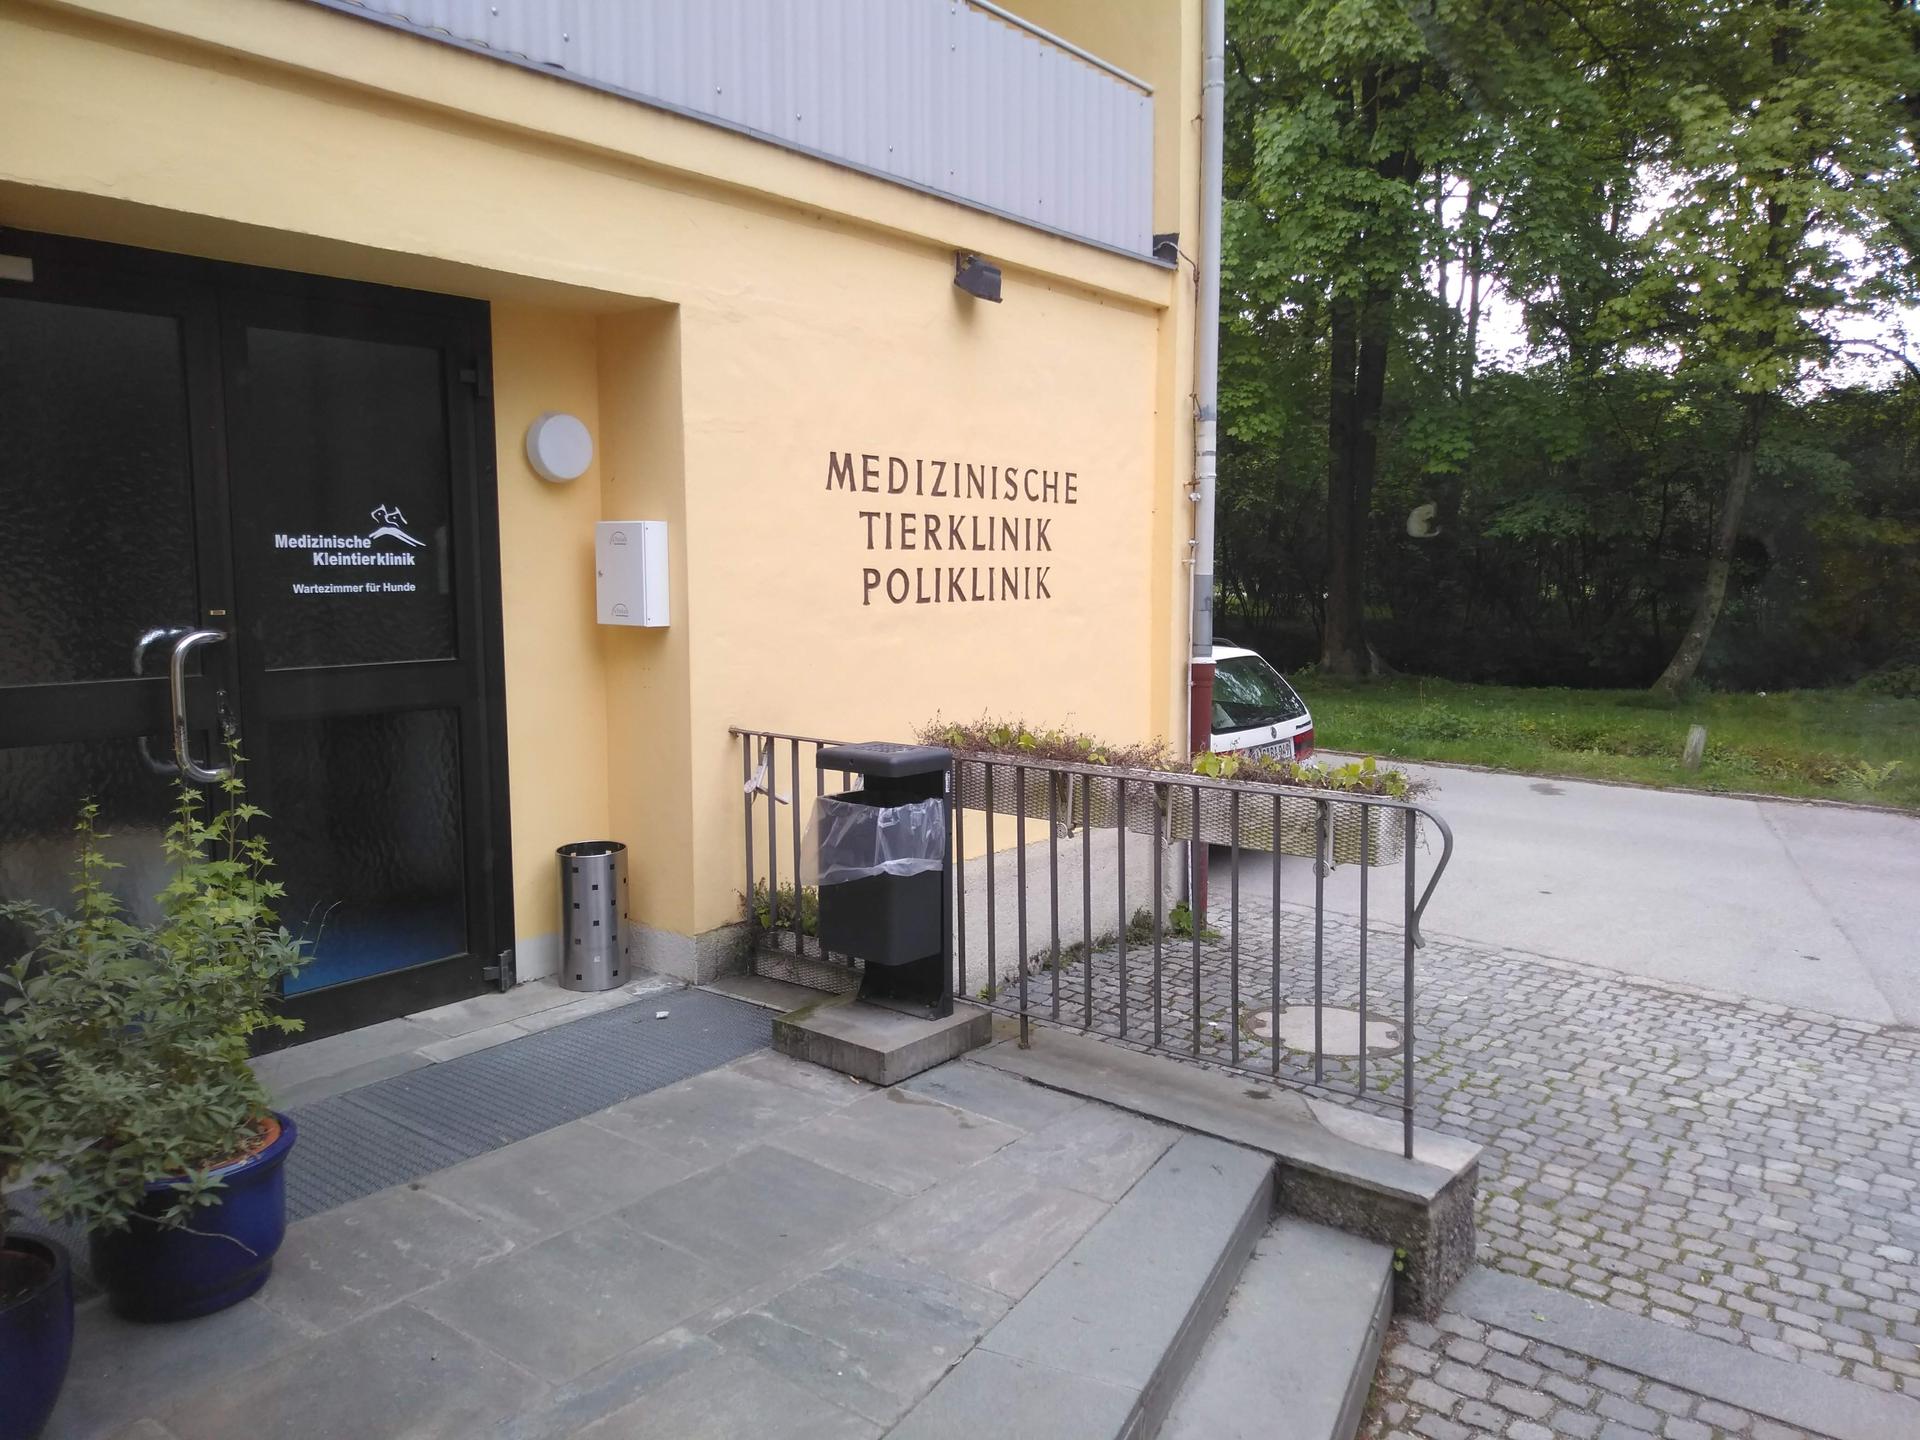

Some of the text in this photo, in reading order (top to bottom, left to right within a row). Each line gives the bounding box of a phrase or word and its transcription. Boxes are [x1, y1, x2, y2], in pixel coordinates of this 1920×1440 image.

[824, 450, 1079, 506] MEDIZINISCHE
[275, 533, 372, 549] Medizinische
[857, 509, 1053, 553] TIERKLINIK
[312, 551, 416, 566] Kleintierklinik
[292, 582, 416, 594] Wartezimmer für Hunde
[861, 565, 1052, 607] POLIKLINIK
